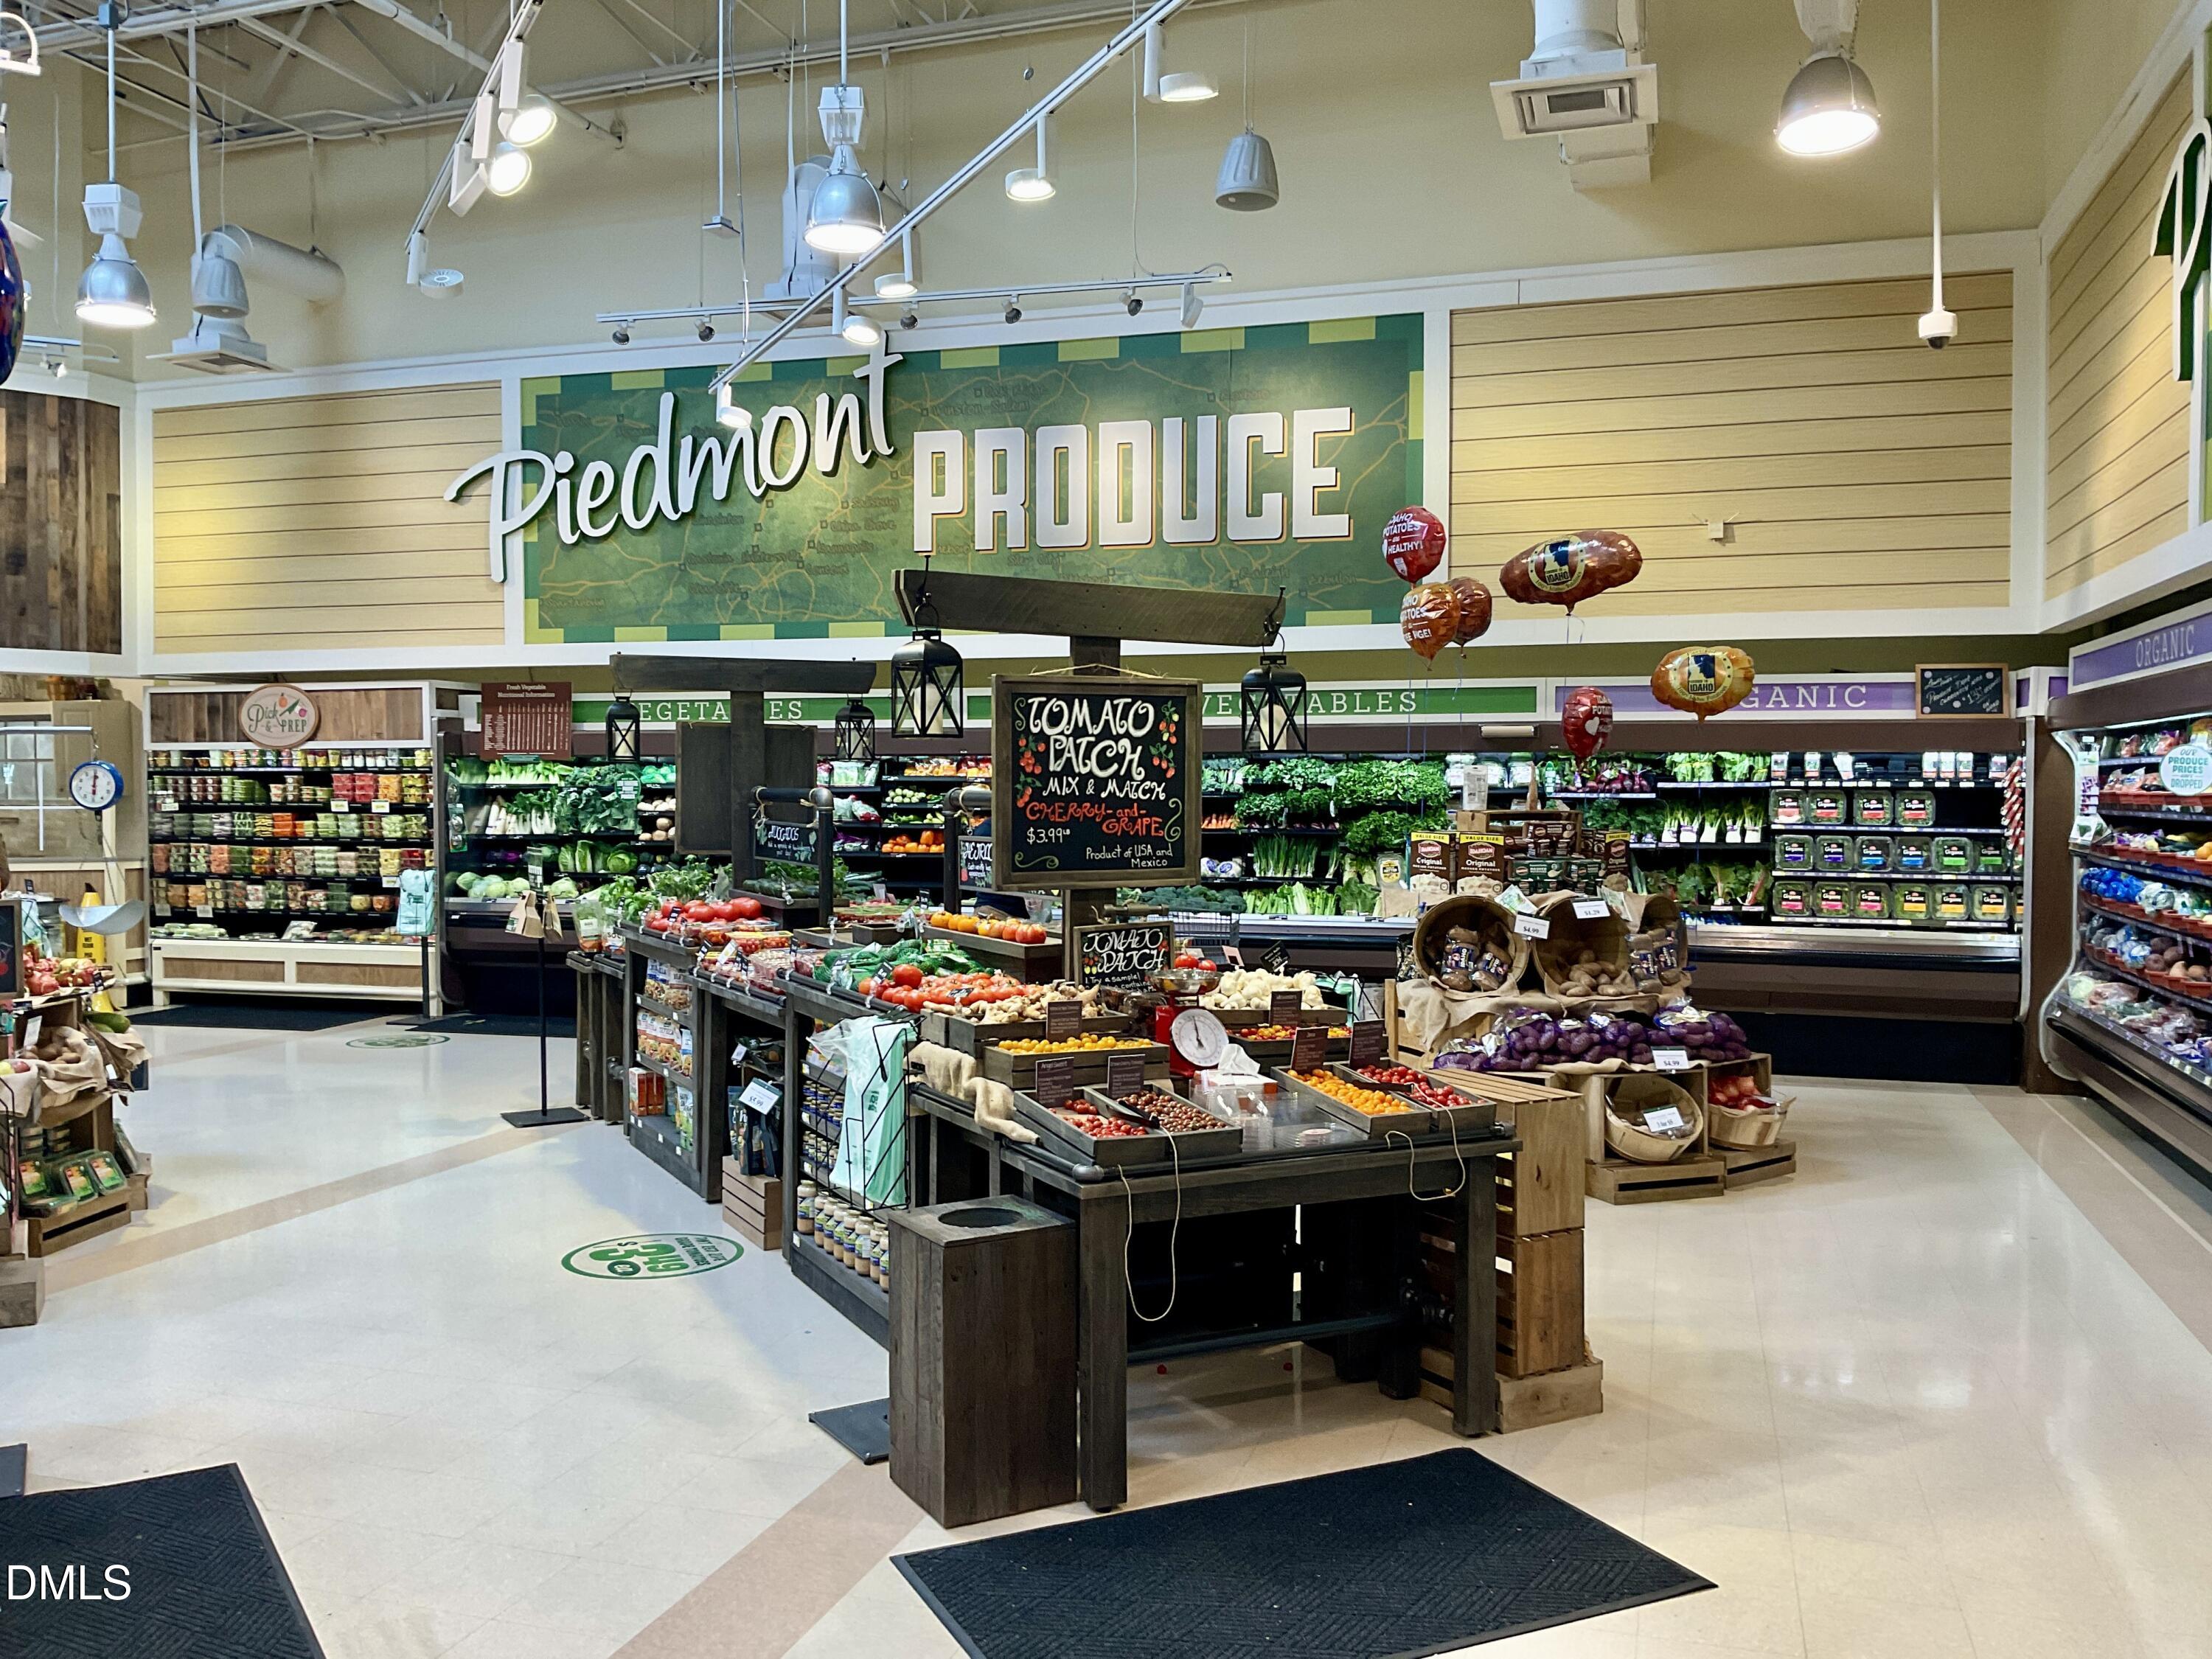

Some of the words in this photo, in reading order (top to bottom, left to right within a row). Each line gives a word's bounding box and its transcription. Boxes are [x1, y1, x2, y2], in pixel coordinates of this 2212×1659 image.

[445, 330, 902, 582] Piedmont
[914, 407, 1354, 553] PRODUCE
[1382, 522, 1421, 538] POTATOES
[1388, 540, 1424, 554] HEALTHY!
[1546, 571, 1570, 583] IDAHO
[1401, 607, 1427, 622] TOES
[2136, 625, 2194, 667] ORGANIC
[1690, 683, 1713, 692] IDAHO
[1203, 691, 1416, 714] VETABLES
[1740, 685, 1866, 709] GANIC
[248, 702, 280, 732] Pick
[639, 701, 802, 720] EGETAES
[1028, 697, 1155, 737] TOMATO
[265, 721, 273, 732] &
[281, 720, 307, 732] PREP
[1049, 735, 1145, 780] PATCH
[2168, 757, 2208, 765] PRODUCE
[2172, 765, 2203, 773] PRICES
[1043, 776, 1079, 796] MIX
[1085, 779, 1095, 794] &
[1101, 779, 1166, 799] MATCH
[2171, 779, 2202, 789] DROPPED
[1102, 817, 1164, 836] GRAPE
[1087, 846, 1121, 860] Product
[1124, 848, 1133, 858] of
[1135, 844, 1153, 855] USA
[1156, 844, 1172, 857] and
[1132, 858, 1167, 868] Mexico
[1416, 858, 1442, 866] Original
[1466, 860, 1496, 868] Original
[1523, 926, 1540, 934] $4.99
[1083, 929, 1163, 953] TOMATO
[1097, 948, 1165, 973] PATCH
[1090, 976, 1102, 985] Try
